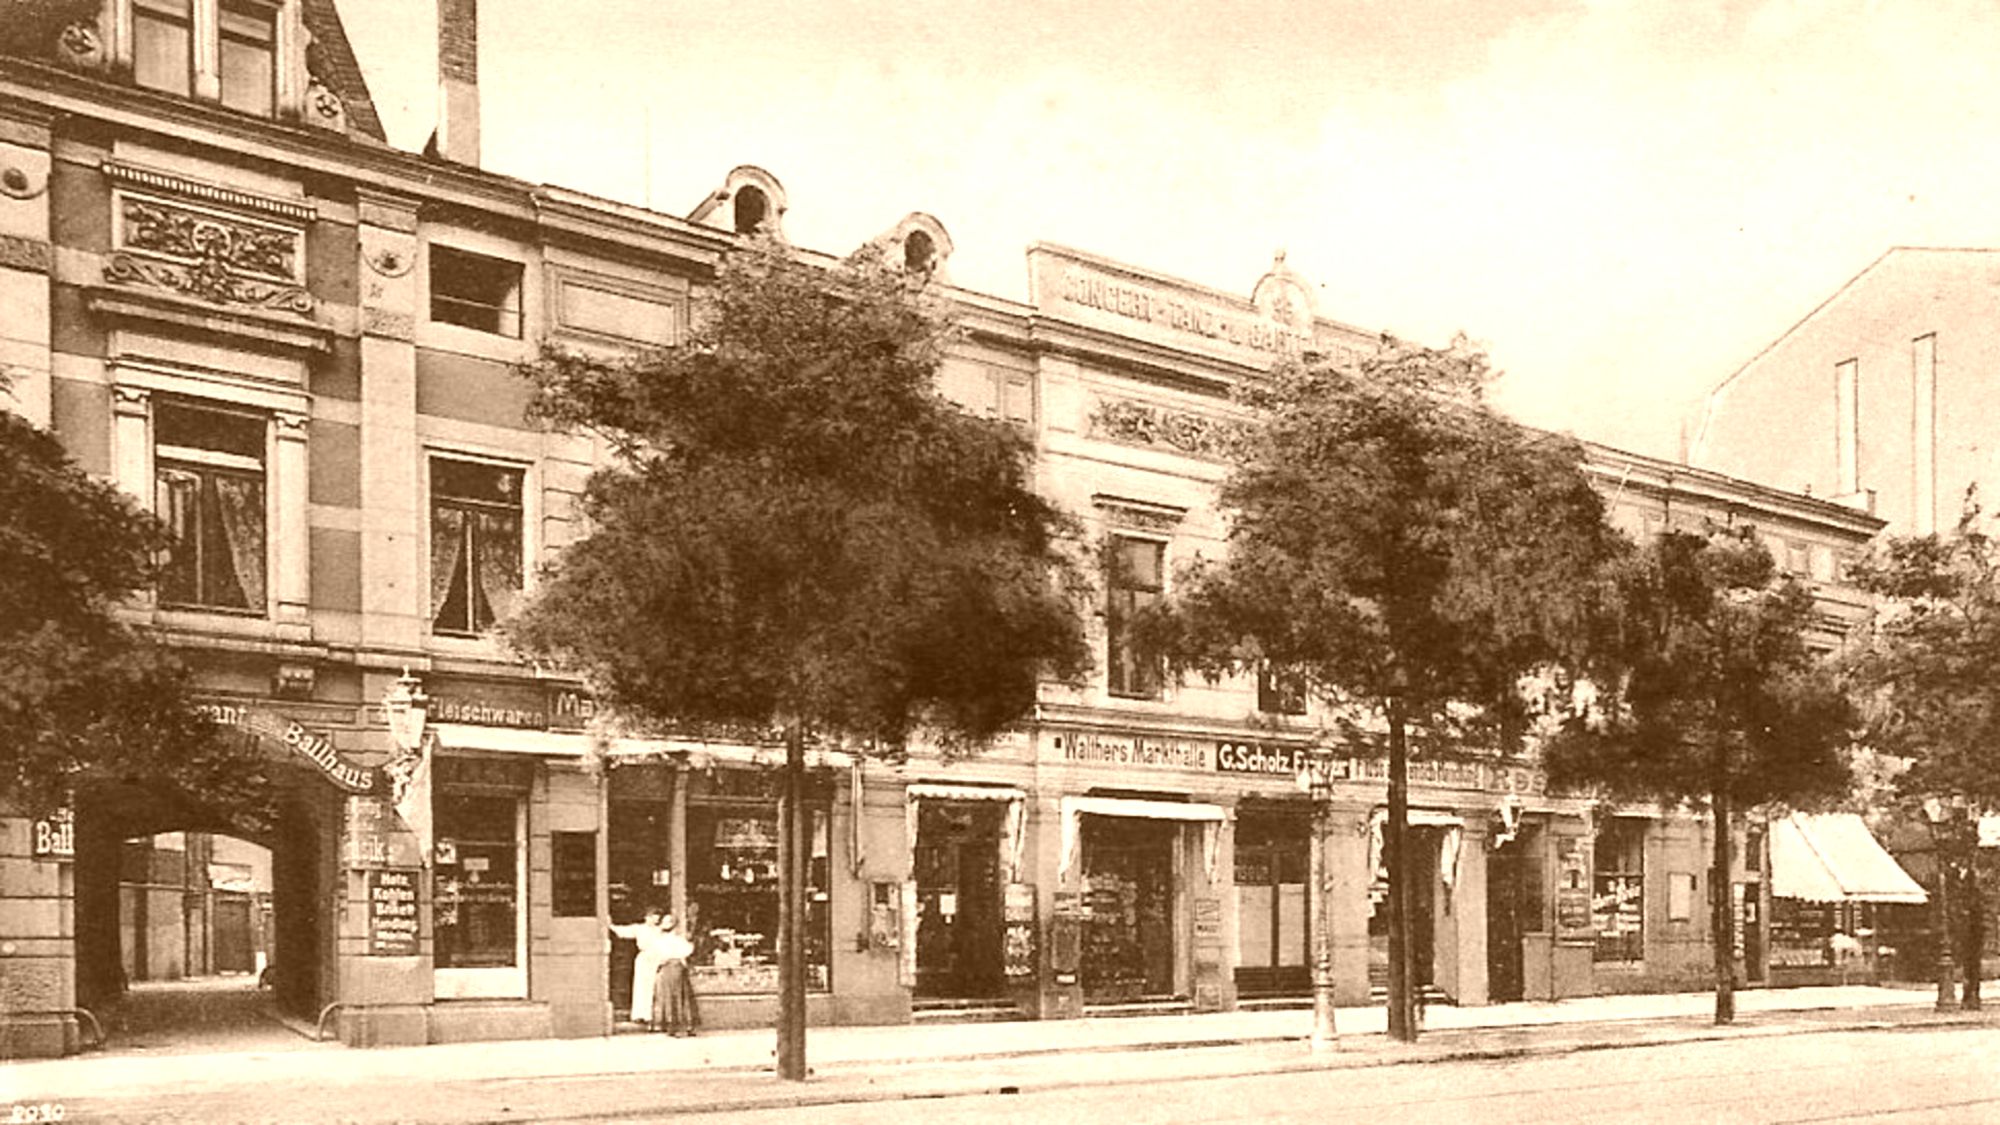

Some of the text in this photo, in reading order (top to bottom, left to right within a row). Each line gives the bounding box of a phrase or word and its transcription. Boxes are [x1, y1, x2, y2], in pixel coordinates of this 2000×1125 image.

[283, 721, 374, 790] Ballhaus
[1064, 732, 1206, 768] Walthers Markthalle
